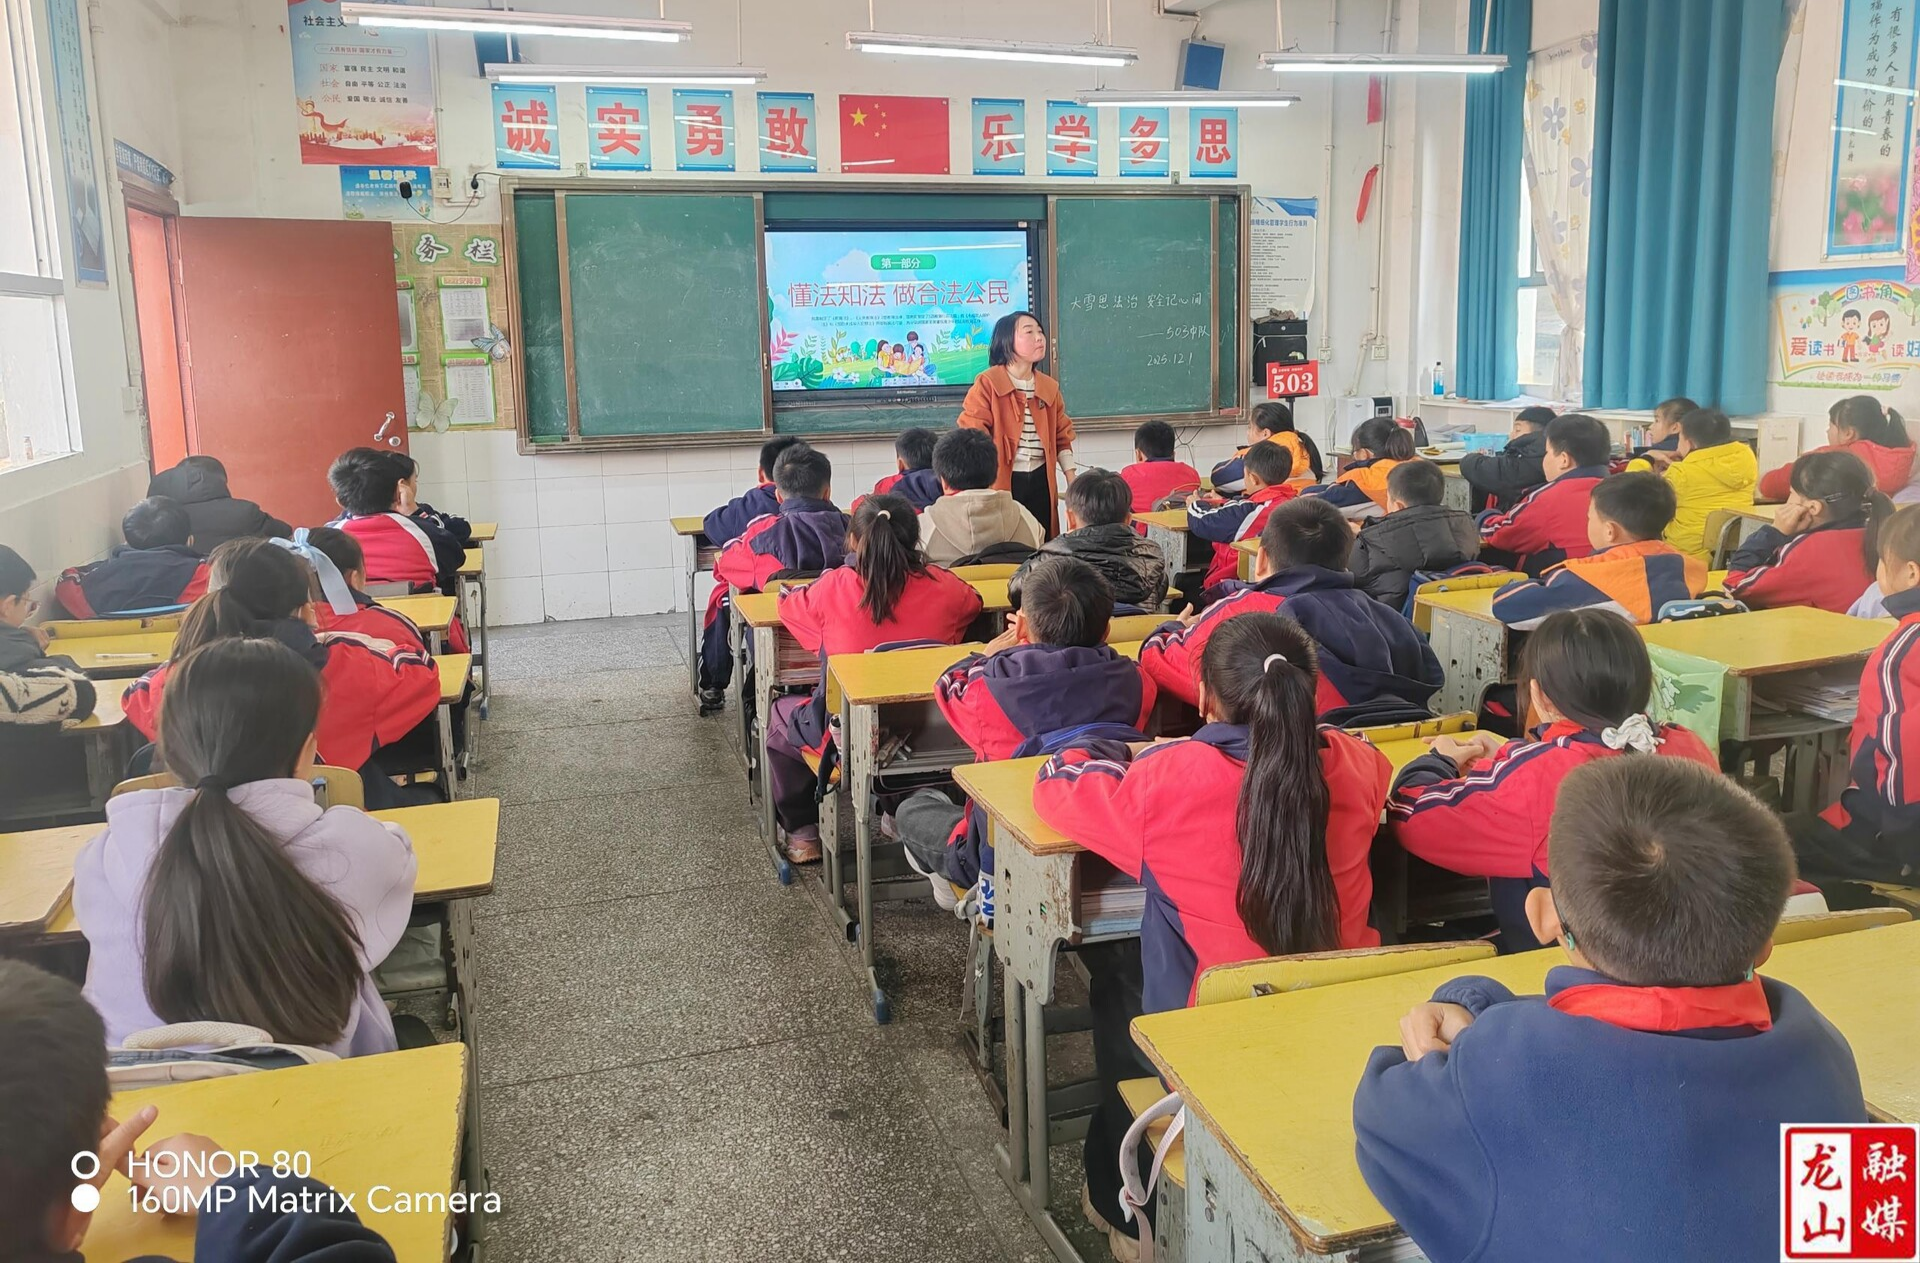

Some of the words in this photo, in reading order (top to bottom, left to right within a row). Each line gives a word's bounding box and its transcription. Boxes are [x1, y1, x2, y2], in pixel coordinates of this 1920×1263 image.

[303, 15, 348, 28] 社会主义
[320, 63, 339, 73] 国家
[344, 65, 358, 73] 富强
[321, 78, 340, 88] 社会
[322, 94, 342, 104] 公民
[379, 96, 393, 104] 诚信
[502, 99, 550, 154] 诚
[597, 102, 641, 156] 实
[686, 104, 723, 156] 勇
[765, 107, 809, 159] 敢
[981, 114, 1017, 161] 乐
[1054, 115, 1090, 163] 学
[1130, 116, 1160, 164] 多
[1196, 118, 1231, 164] 思
[881, 257, 921, 269] 第一部分
[788, 281, 886, 308] 懂法知法
[892, 280, 1010, 307] 做合法公民
[1846, 283, 1893, 301] 图书角
[1070, 293, 1138, 312] 大雪思法治
[1790, 337, 1835, 356] 爱读书
[1272, 372, 1314, 394] 503
